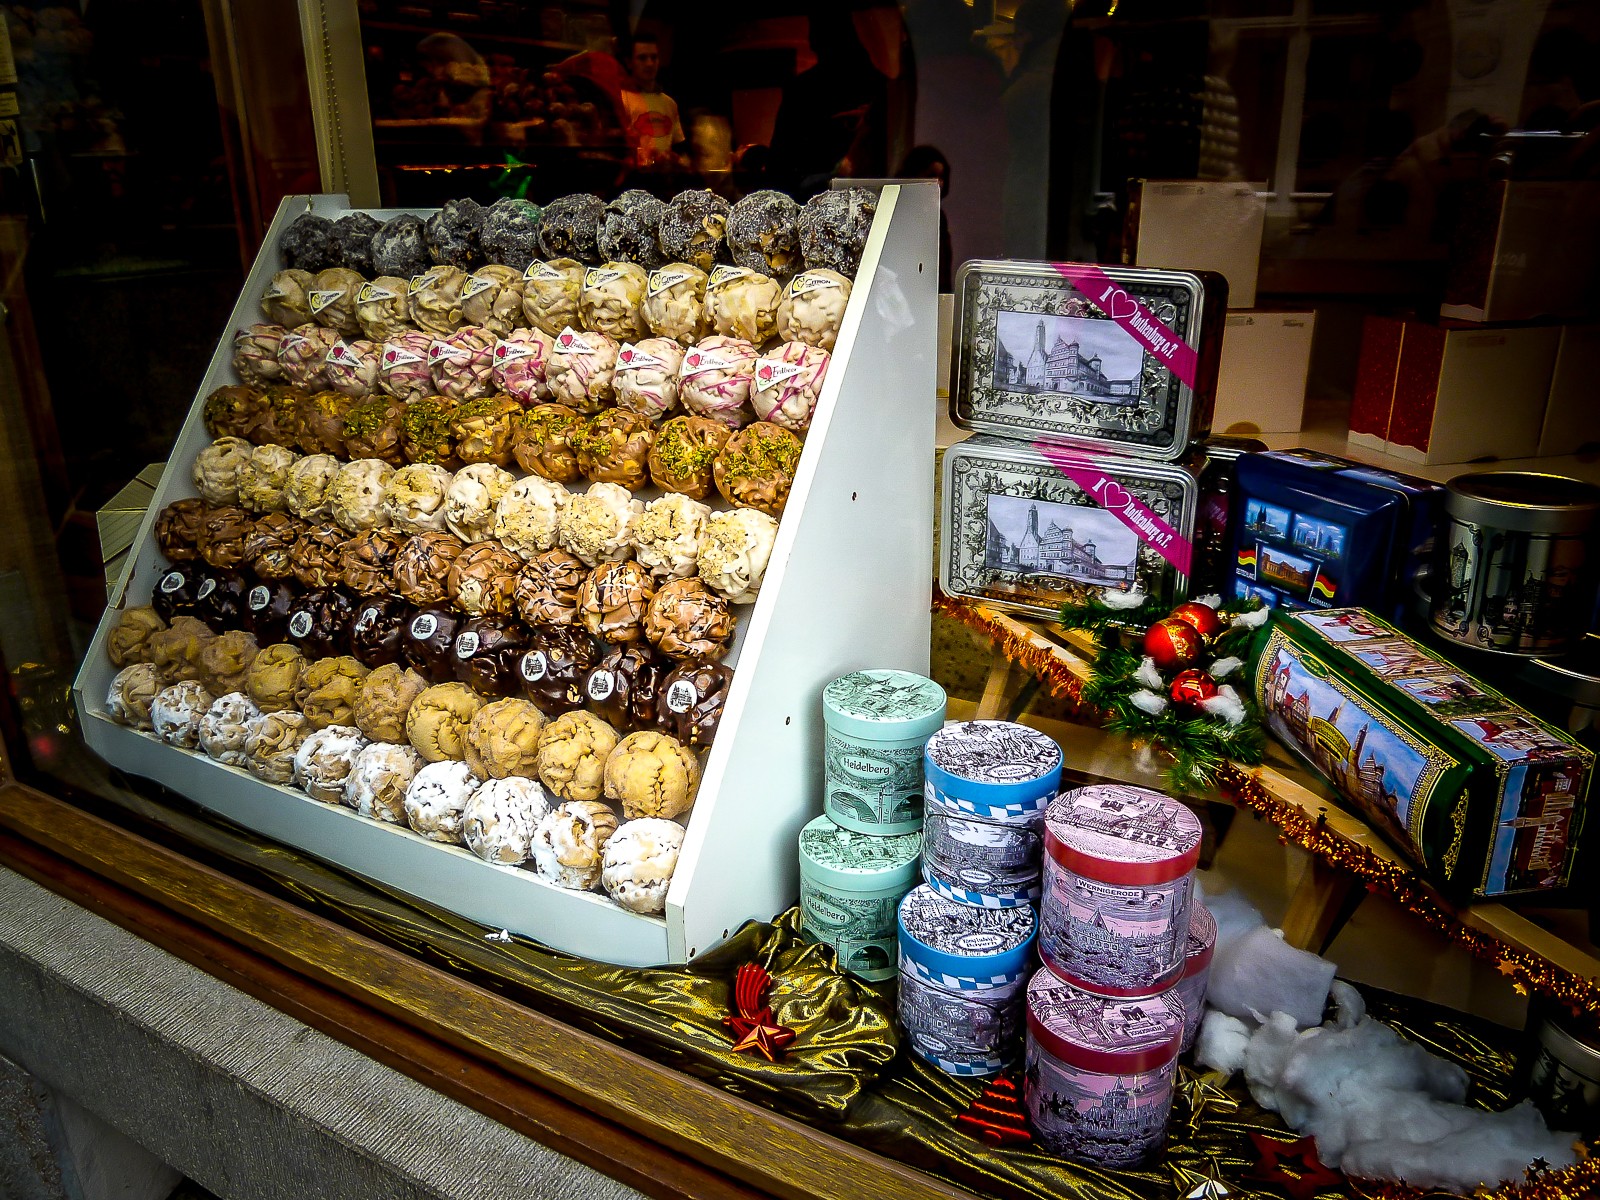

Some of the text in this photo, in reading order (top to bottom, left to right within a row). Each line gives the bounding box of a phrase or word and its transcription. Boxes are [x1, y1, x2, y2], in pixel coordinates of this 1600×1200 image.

[805, 278, 831, 287] CITRON
[1100, 286, 1113, 302] I
[1129, 311, 1166, 352] Rothenburg
[772, 364, 798, 378] Erdbeer
[1092, 478, 1106, 492] I
[1123, 502, 1160, 541] Rothenburg
[843, 757, 890, 776] Heidelberg
[1078, 879, 1140, 897] WERNIGERODE
[807, 896, 846, 923] Heidelberg
